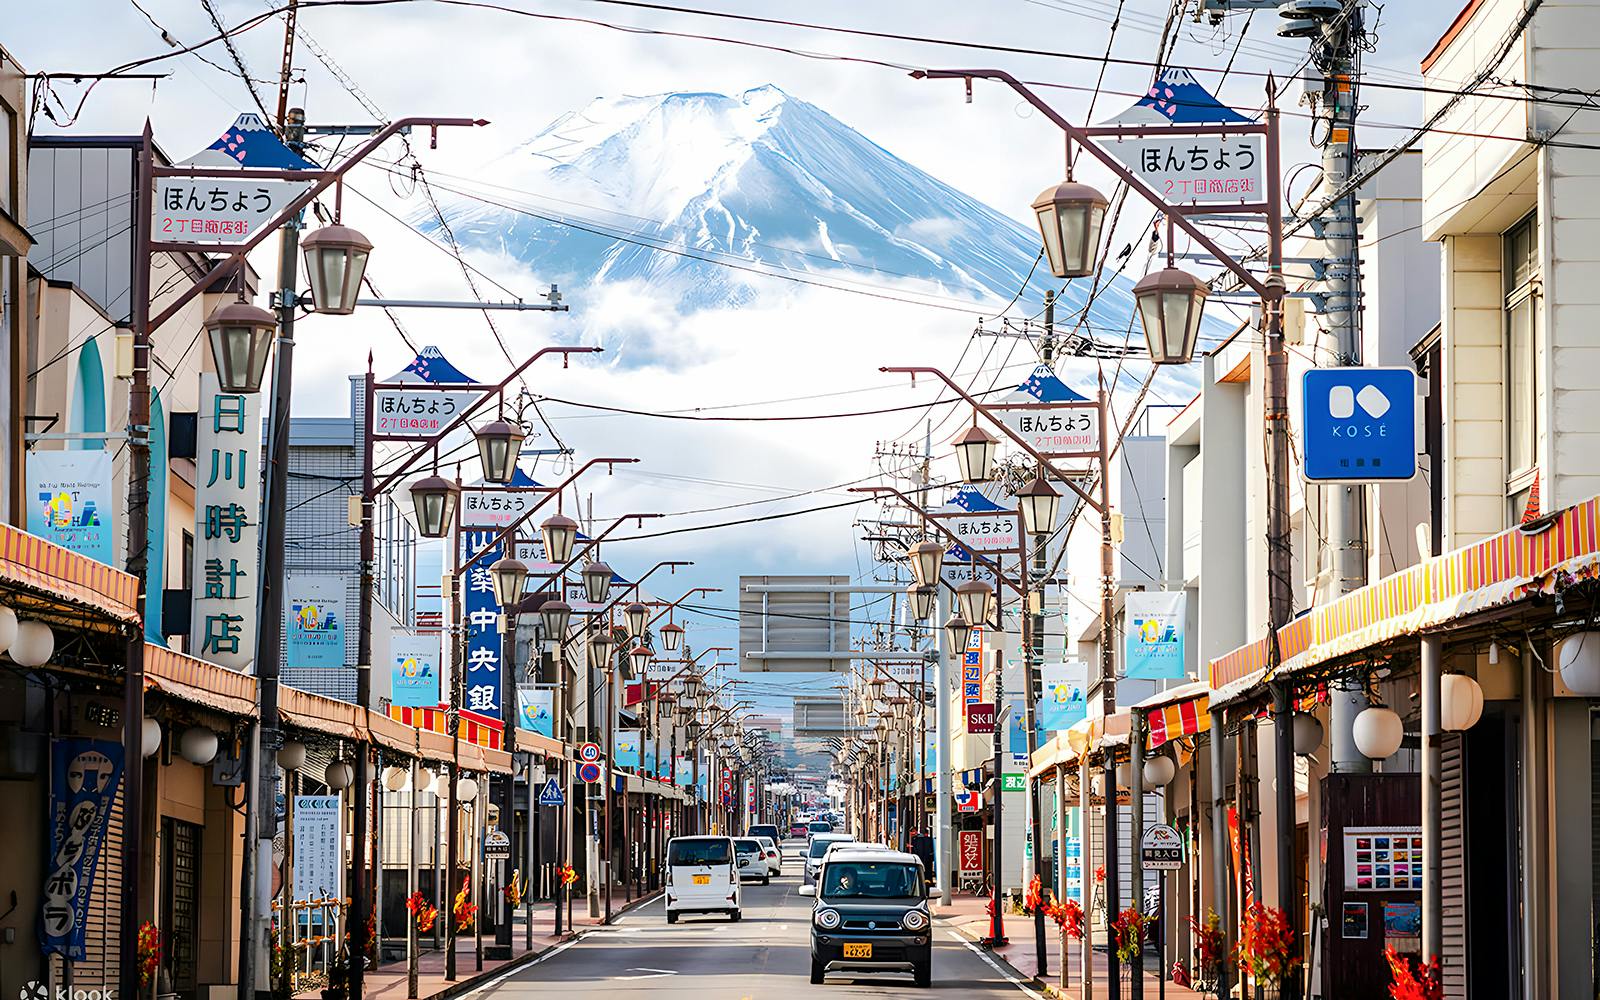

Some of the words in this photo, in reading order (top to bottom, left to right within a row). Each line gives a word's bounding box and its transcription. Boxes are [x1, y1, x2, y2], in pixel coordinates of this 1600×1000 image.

[1141, 144, 1255, 172] ほんちょう
[164, 186, 272, 213] ほんちょう
[381, 396, 455, 415] ほんちょう
[1019, 414, 1091, 433] ほんちょう
[467, 497, 525, 511] ほんちょう
[201, 393, 248, 655] 日川時計店
[958, 519, 1013, 535] ほんちょう
[584, 747, 596, 757] 40
